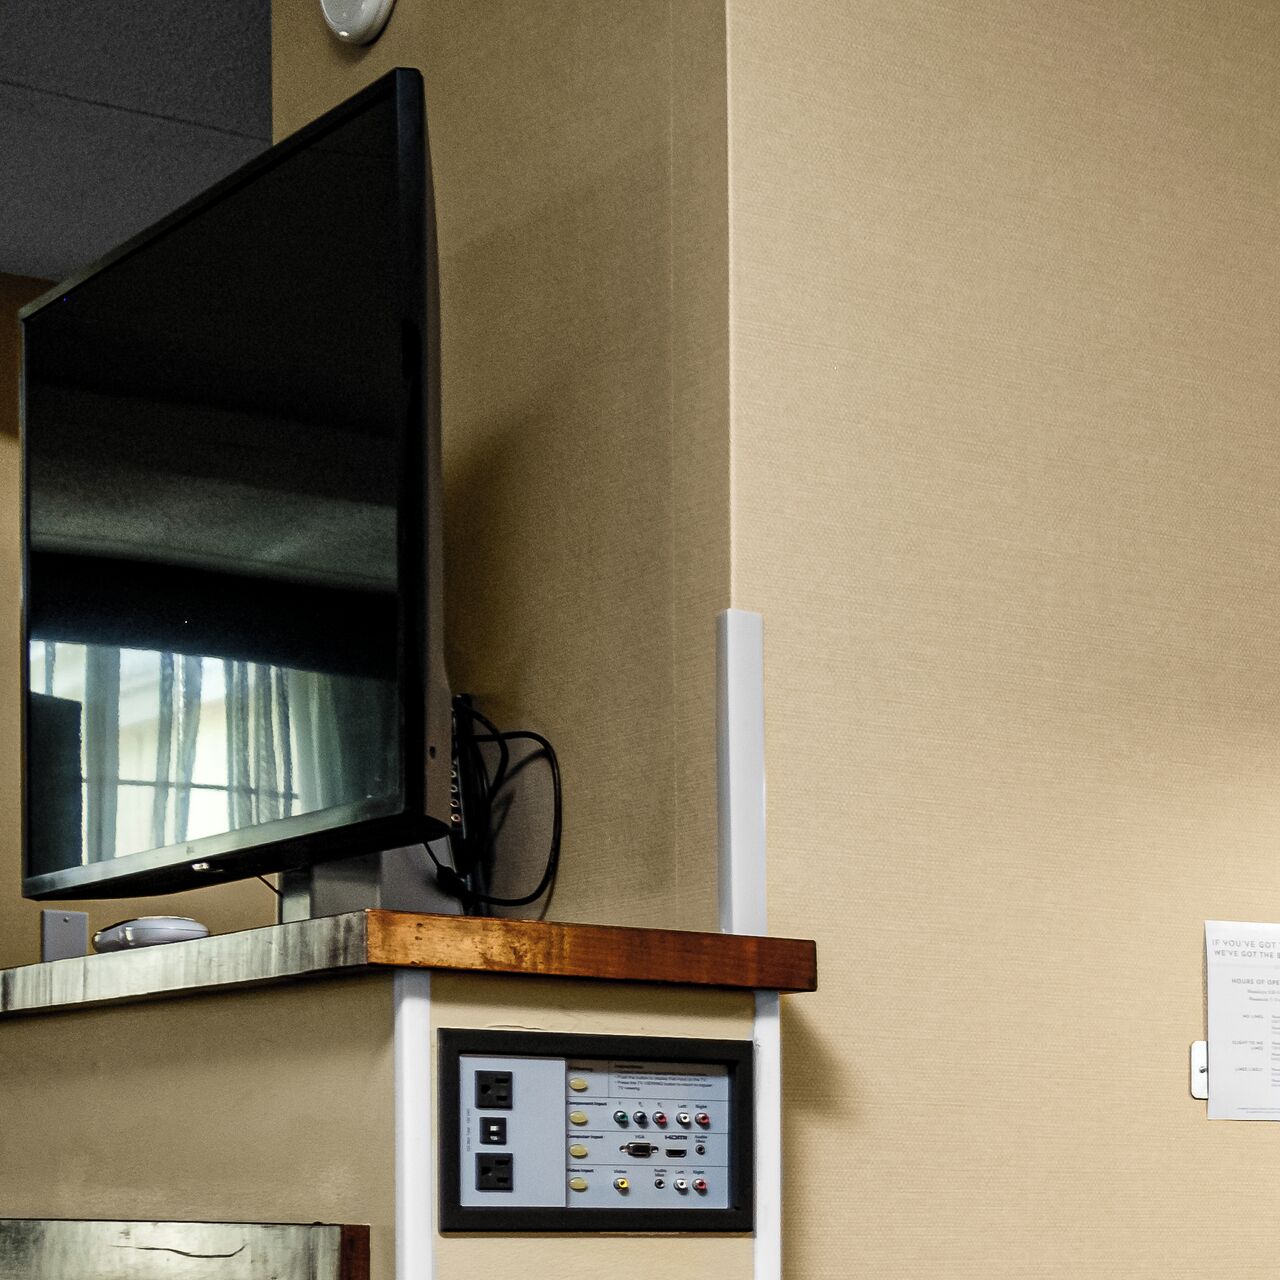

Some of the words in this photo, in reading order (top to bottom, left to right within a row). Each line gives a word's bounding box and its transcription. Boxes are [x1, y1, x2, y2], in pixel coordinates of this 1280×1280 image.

[1222, 939, 1256, 948] YOU'VE
[1258, 940, 1276, 949] GOT
[1214, 949, 1238, 957] WE'VE
[1240, 950, 1257, 958] GOT
[1260, 951, 1274, 959] THE
